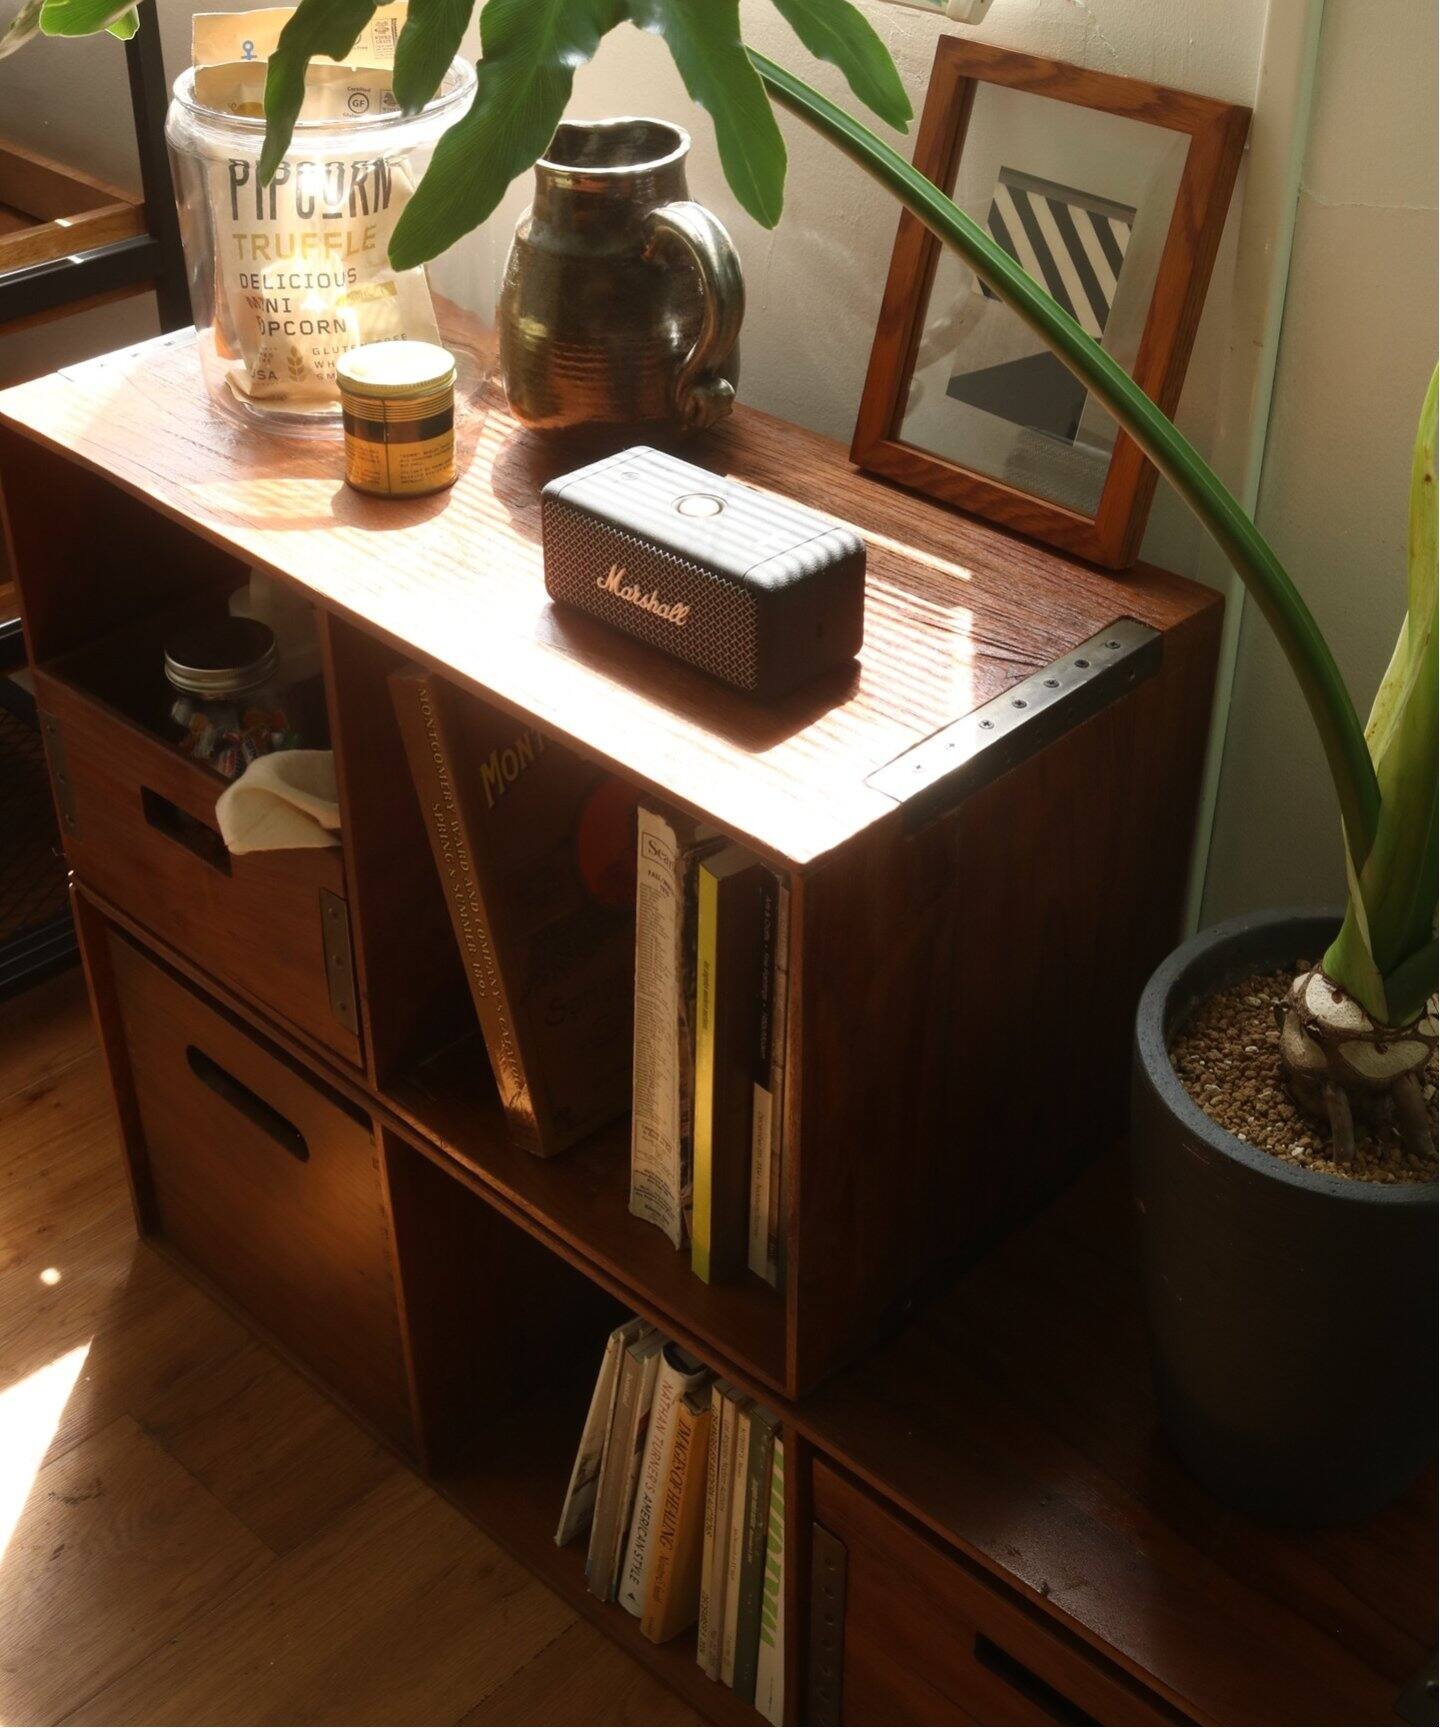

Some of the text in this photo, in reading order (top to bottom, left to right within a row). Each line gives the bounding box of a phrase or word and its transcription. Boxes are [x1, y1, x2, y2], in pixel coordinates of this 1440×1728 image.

[228, 157, 392, 221] PIPCORN
[232, 224, 377, 262] TRUFFLE
[239, 267, 357, 291] DELICIOUS
[256, 315, 347, 336] OPCORN
[596, 563, 693, 627] Marshall
[417, 688, 456, 812] MONTGOMERY
[450, 820, 469, 871] WARD
[463, 877, 480, 913] AND
[432, 803, 454, 863] SPRING
[453, 883, 478, 953] SUMMER
[670, 1421, 691, 1479] IMAGES
[629, 1383, 674, 1585] NATHAN TURNER'S AMERICAN STYLE
[660, 1490, 681, 1552] HEALING
